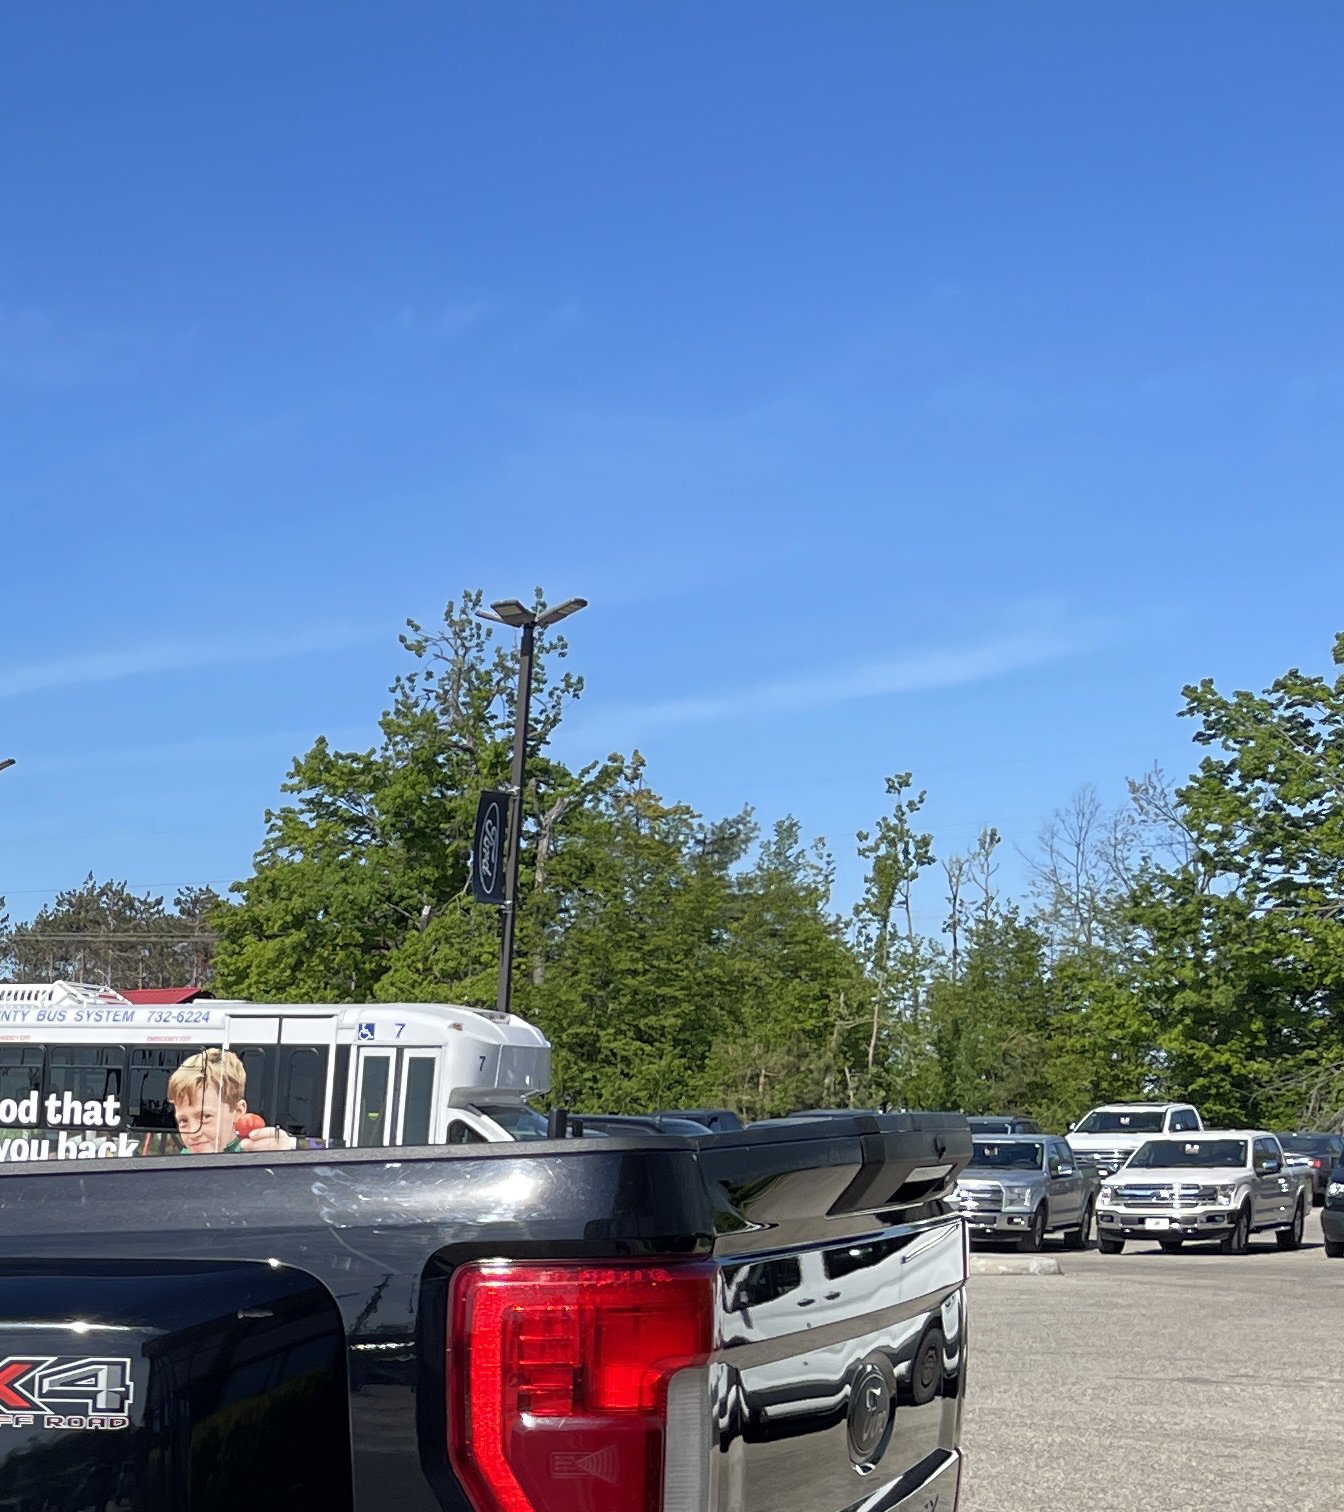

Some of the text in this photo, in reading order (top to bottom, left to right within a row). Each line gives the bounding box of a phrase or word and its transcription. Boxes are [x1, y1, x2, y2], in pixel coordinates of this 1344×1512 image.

[482, 819, 498, 878] Ford
[37, 1010, 66, 1023] BUS
[74, 1010, 135, 1023] SYSTEM
[146, 1010, 211, 1024] 732-6224
[394, 1023, 407, 1039] 7
[479, 1055, 487, 1072] 7
[44, 1090, 121, 1126] that
[57, 1130, 140, 1160] back
[43, 1414, 130, 1430] ROAD
